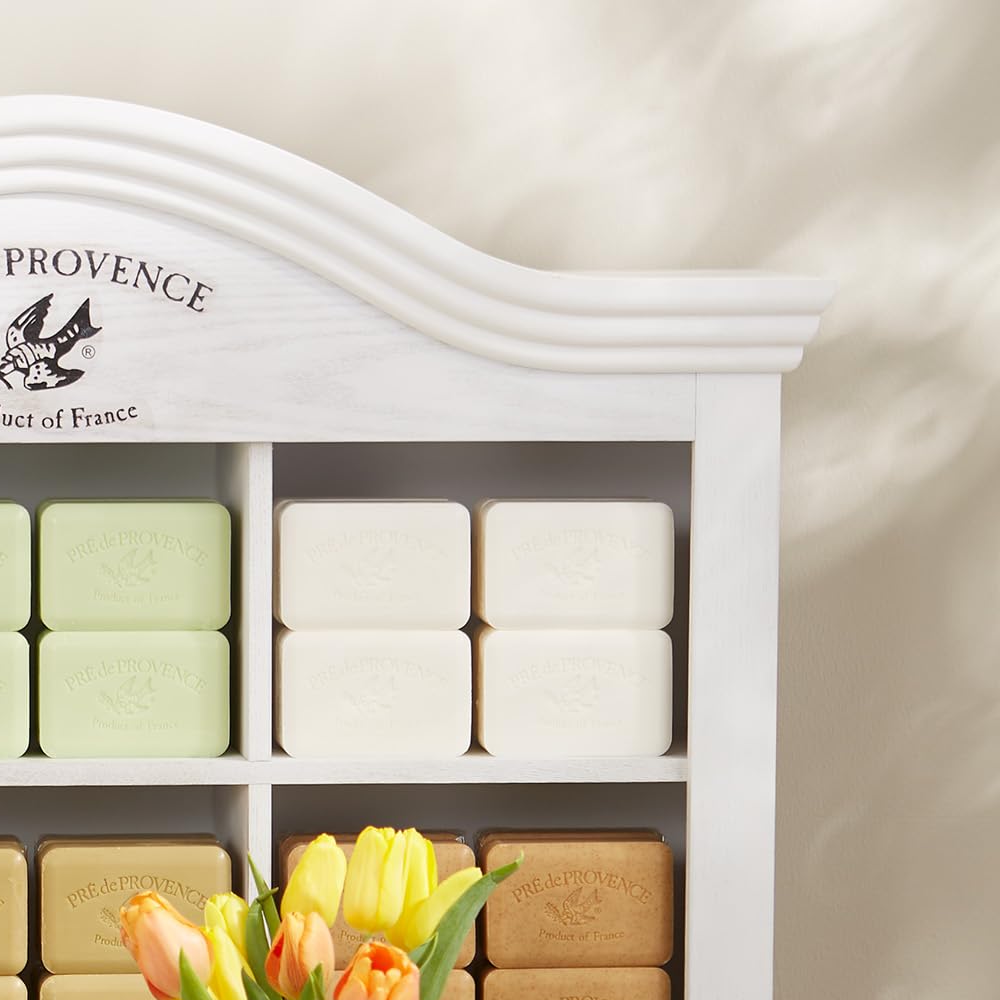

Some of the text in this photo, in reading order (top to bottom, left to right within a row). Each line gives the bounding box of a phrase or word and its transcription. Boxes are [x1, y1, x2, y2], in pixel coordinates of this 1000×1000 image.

[4, 247, 214, 313] PROVENCE
[42, 409, 63, 429] of
[72, 405, 138, 428] France
[118, 532, 209, 566] PROVENCE
[117, 659, 208, 694] PROVENCE
[67, 882, 99, 909] PRÉ
[100, 879, 117, 894] de
[545, 872, 561, 889] de
[563, 871, 652, 905] PROVENCE
[539, 928, 624, 942] Product of France
